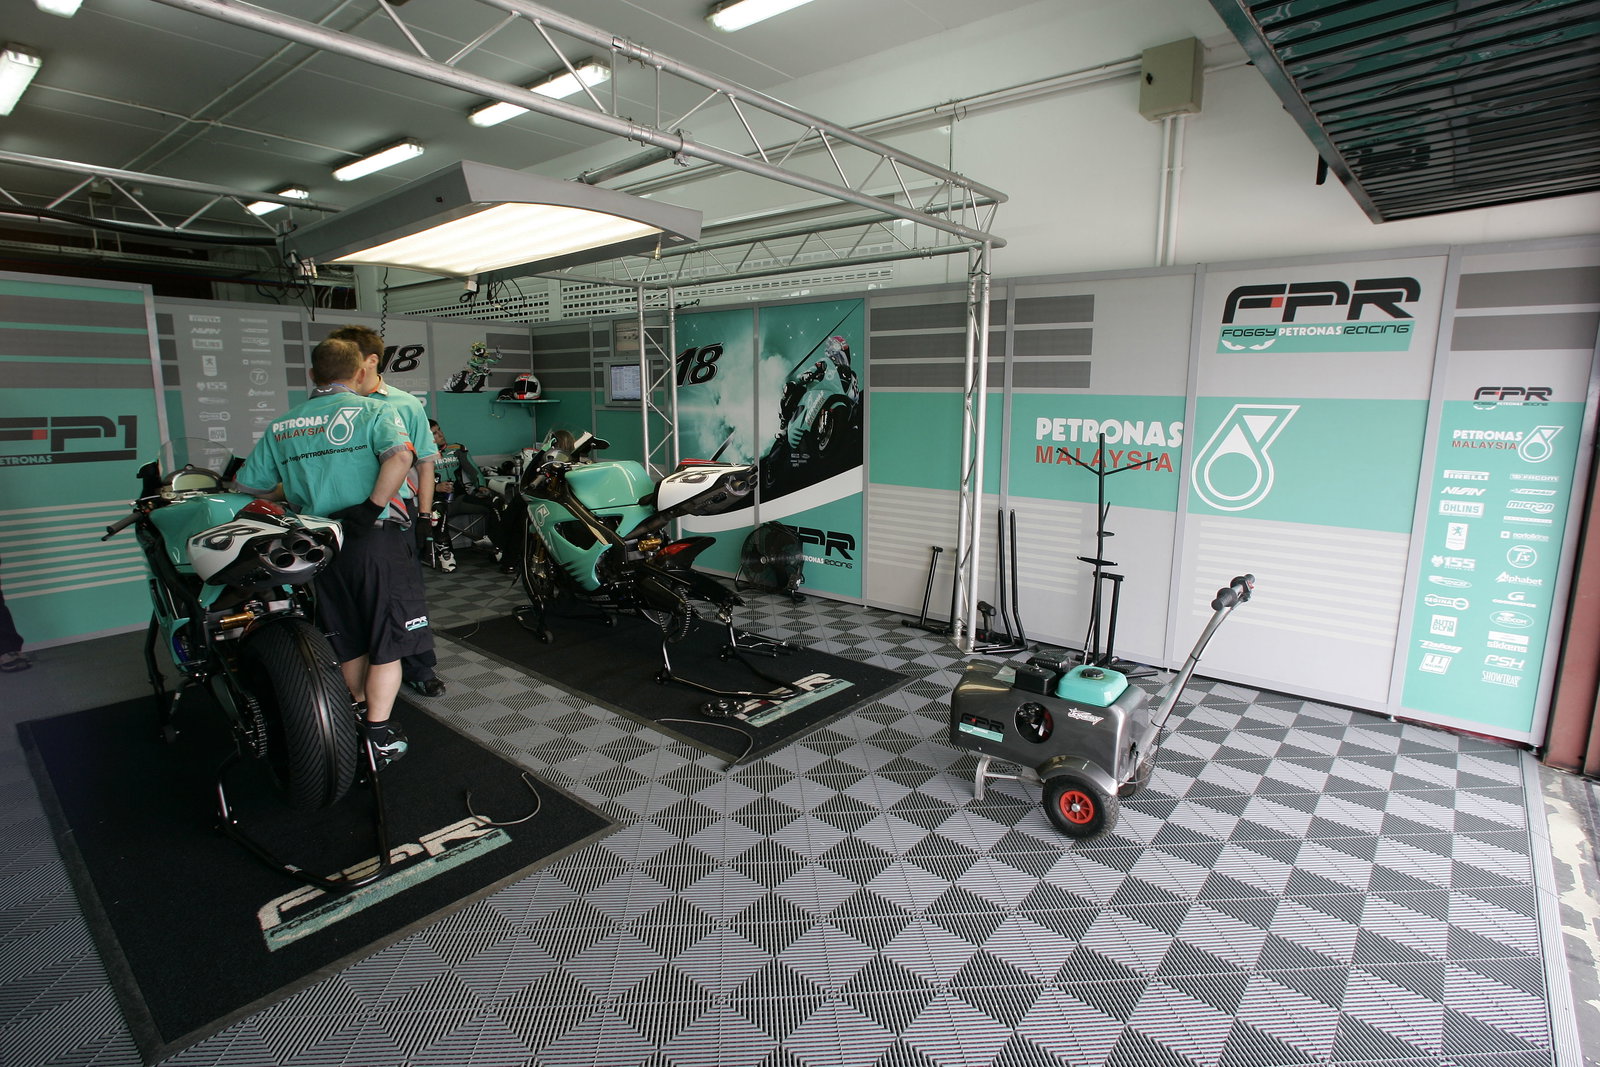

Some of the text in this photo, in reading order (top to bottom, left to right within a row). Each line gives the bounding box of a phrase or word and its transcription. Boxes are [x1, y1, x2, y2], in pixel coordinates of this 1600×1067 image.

[1221, 276, 1422, 324] FPR
[1221, 328, 1277, 338] FOGGY
[1278, 326, 1343, 337] PETRONAS
[676, 342, 725, 388] 18
[1473, 387, 1553, 401] FPR
[272, 414, 329, 433] PETRONAS
[274, 426, 326, 443] MALAYSIA
[1035, 417, 1184, 448] PETRONAS
[1452, 429, 1524, 442] PETRONAS
[1451, 440, 1517, 451] MALAYSIA
[0, 455, 52, 465] ETRONAS
[1035, 445, 1173, 473] MALAYSIA
[785, 524, 856, 561] PR
[796, 553, 824, 565] TRONAS
